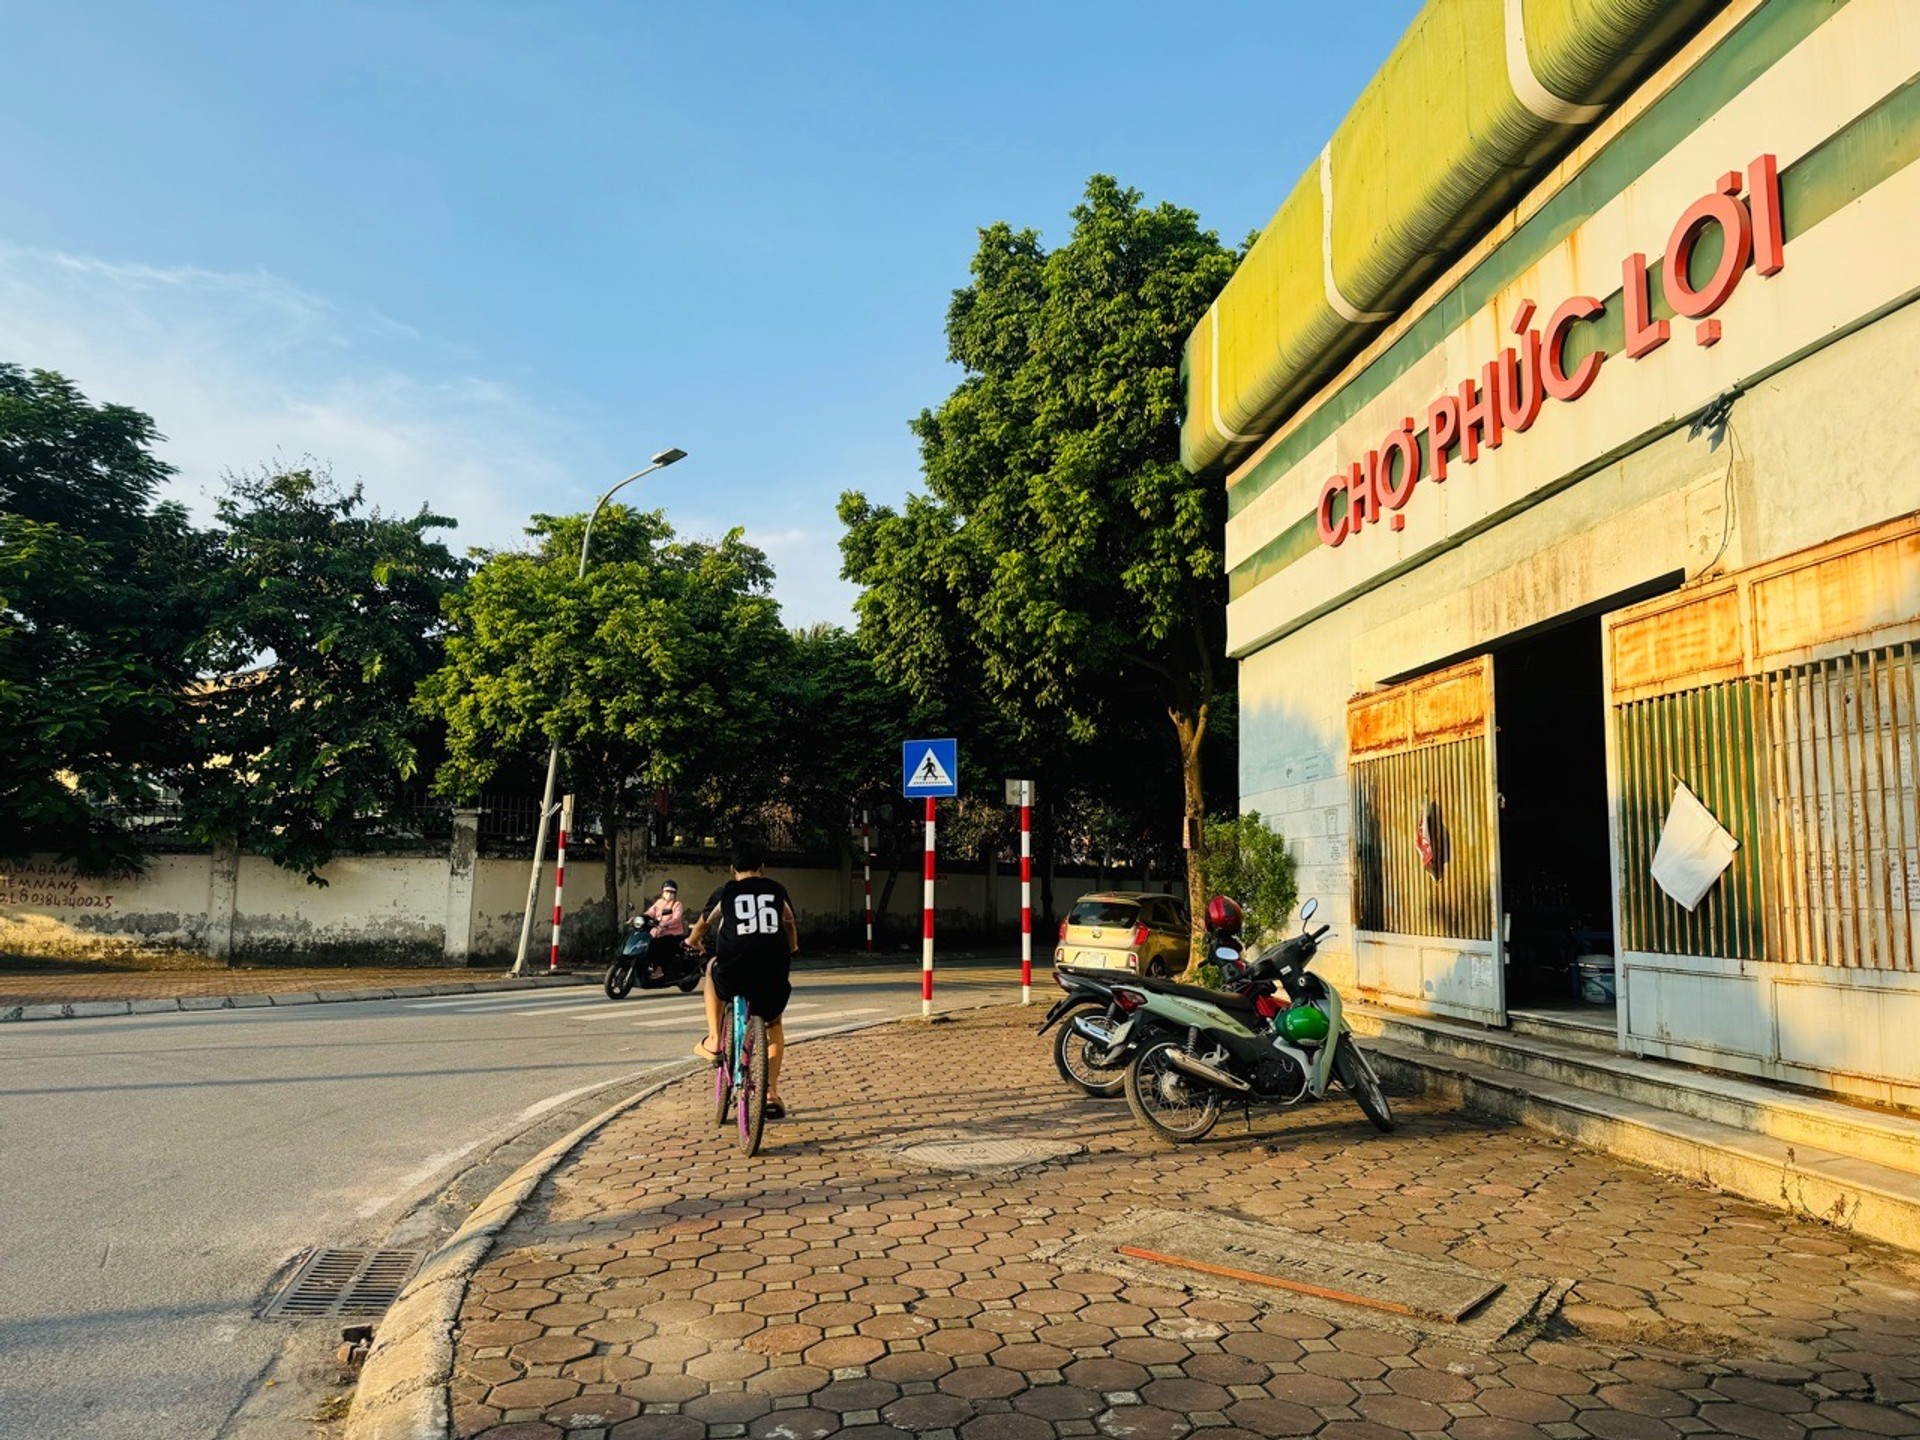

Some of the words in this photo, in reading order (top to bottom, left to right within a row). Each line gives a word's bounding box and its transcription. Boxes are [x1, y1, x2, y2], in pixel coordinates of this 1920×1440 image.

[1317, 417, 1420, 546] CHỢ
[1428, 296, 1607, 483] PHÚC
[1621, 154, 1785, 362] LỢI
[734, 893, 779, 936] 96
